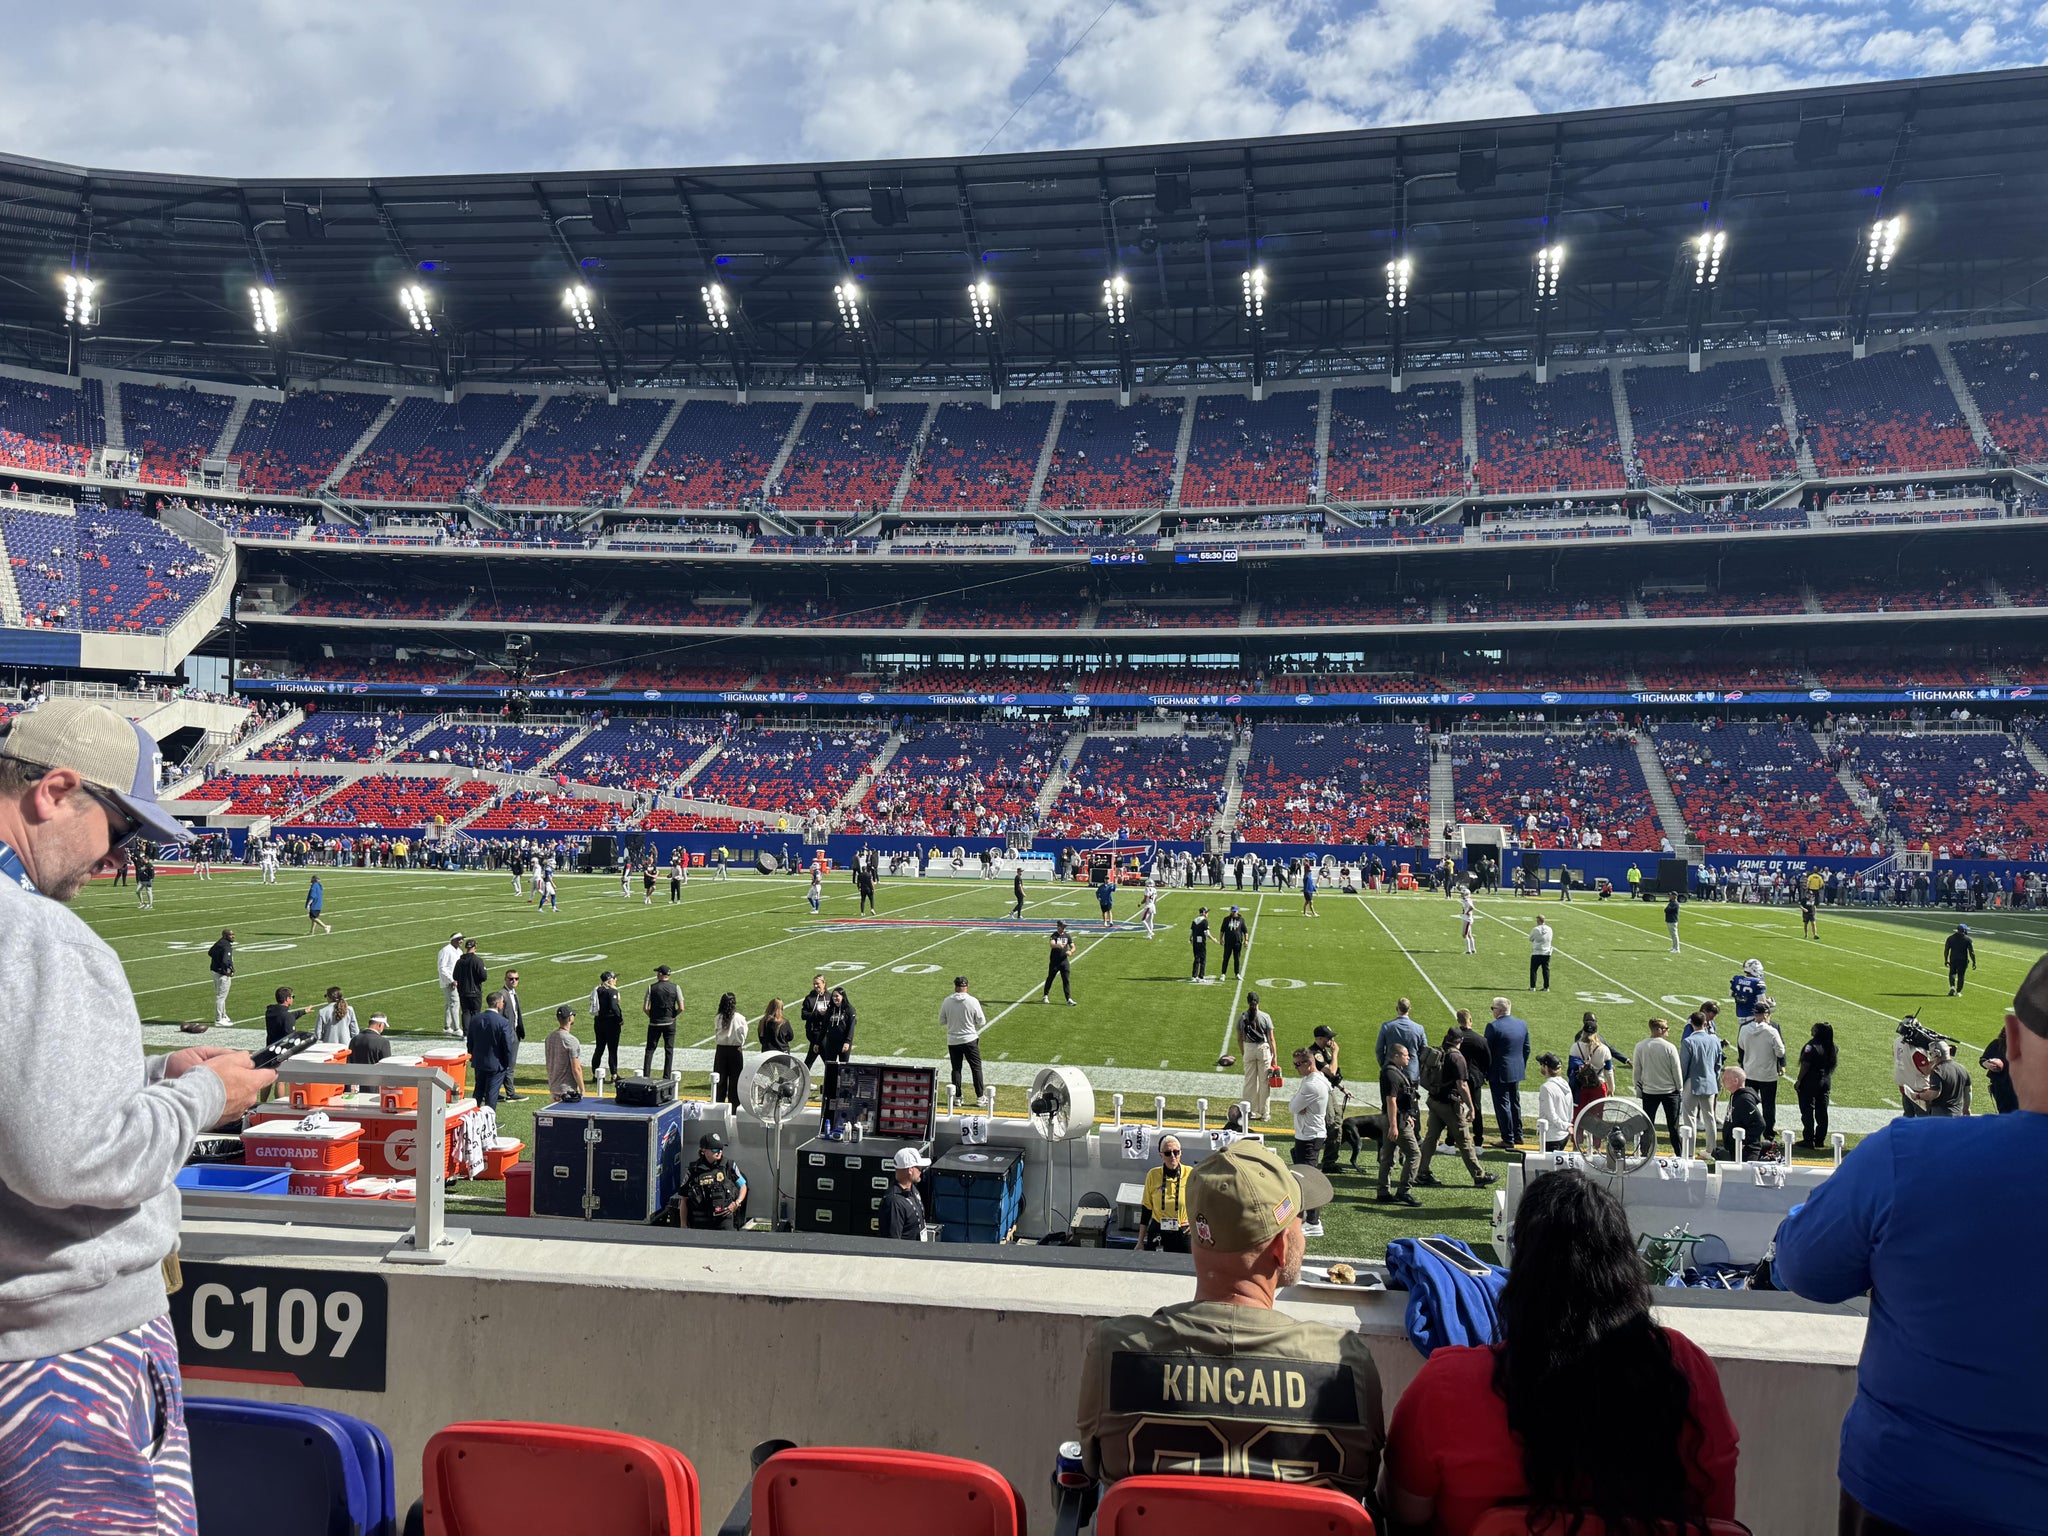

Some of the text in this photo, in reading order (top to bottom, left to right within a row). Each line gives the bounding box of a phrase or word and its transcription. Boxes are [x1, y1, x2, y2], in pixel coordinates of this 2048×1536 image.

[276, 683, 325, 692] HIGHMARK
[723, 692, 768, 701] HIGHMARK
[1637, 693, 1692, 703] HIGHMARK
[1912, 690, 1975, 700] HIGHMARK
[933, 696, 977, 704] HIGHMARK
[1153, 697, 1200, 705] HIGHMARK
[1379, 696, 1430, 704] HIGHMARK
[1769, 861, 1784, 869] OF
[1787, 861, 1807, 869] THE
[1402, 876, 1409, 884] G
[255, 1146, 319, 1159] GATORADE
[191, 1282, 364, 1359] C109
[1163, 1363, 1307, 1409] KINCAID
